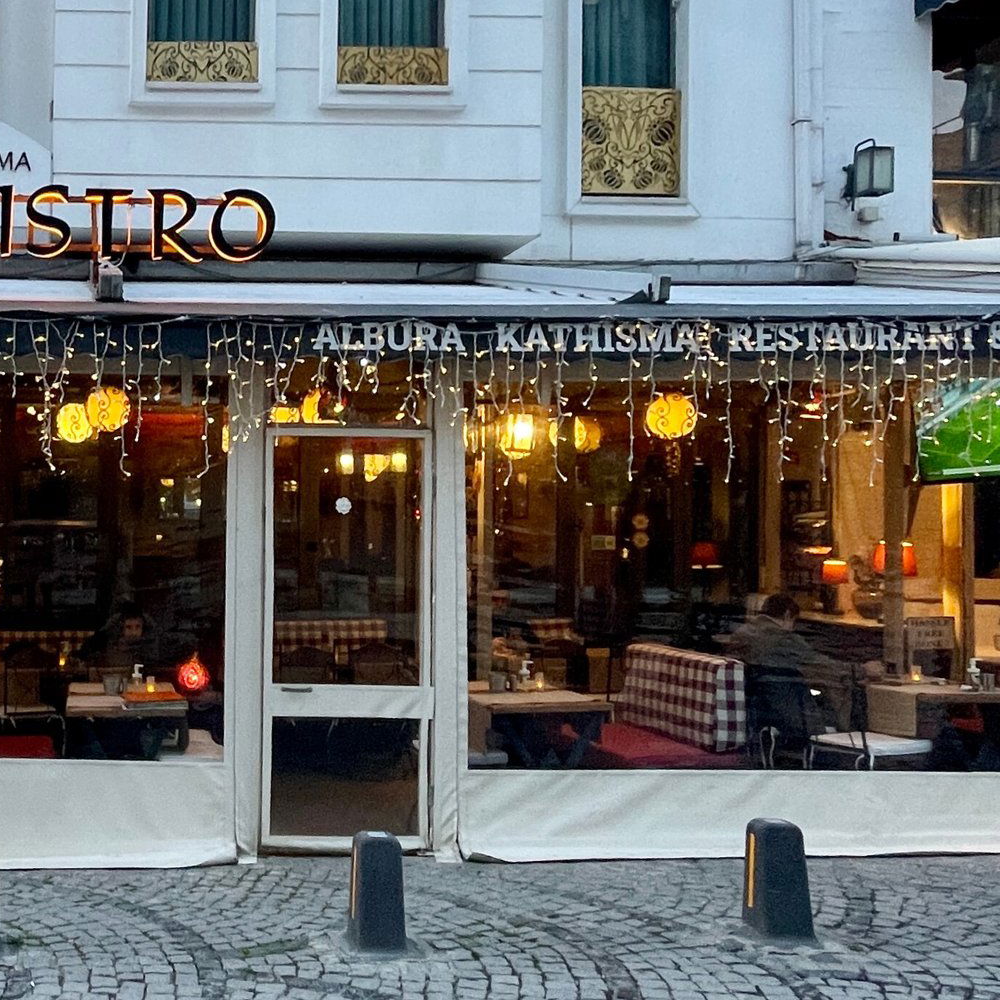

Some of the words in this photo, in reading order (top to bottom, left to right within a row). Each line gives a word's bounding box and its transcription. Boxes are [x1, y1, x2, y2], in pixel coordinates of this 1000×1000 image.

[312, 322, 467, 352] ALBURA
[495, 321, 699, 353] KATHISMA
[729, 320, 979, 351] RESTAURANT
